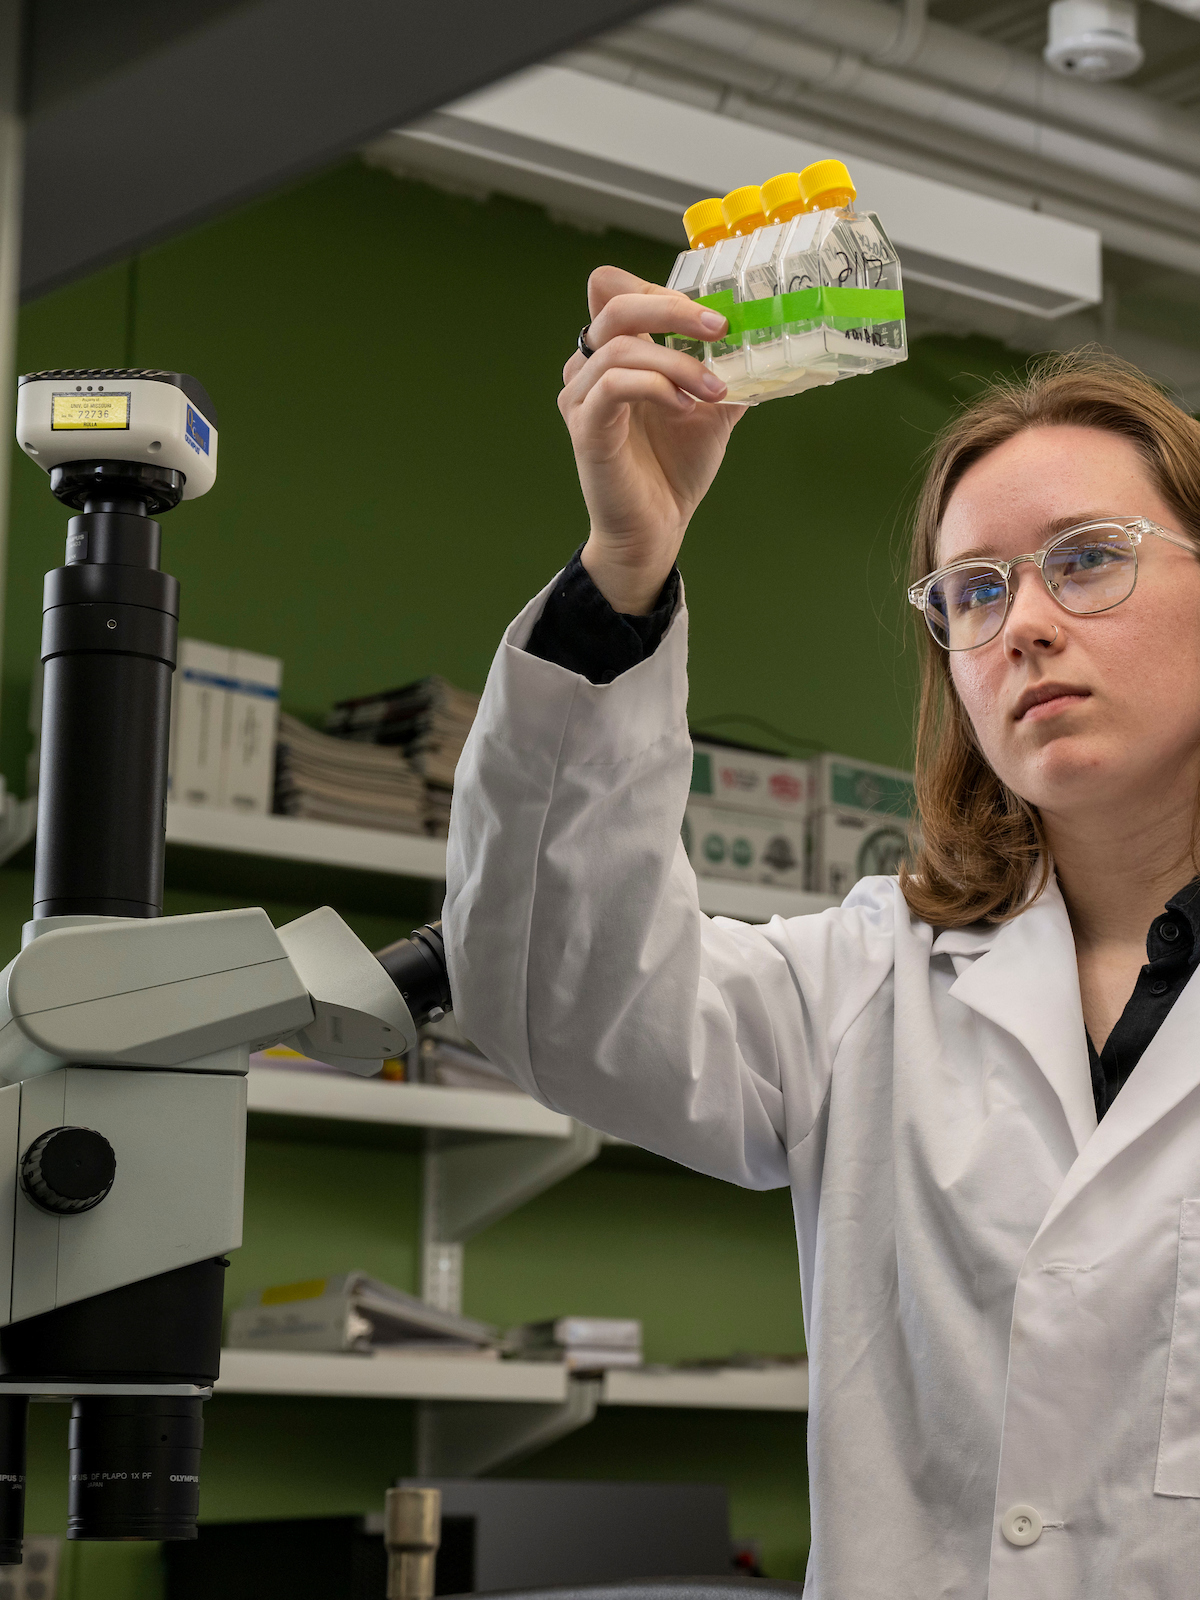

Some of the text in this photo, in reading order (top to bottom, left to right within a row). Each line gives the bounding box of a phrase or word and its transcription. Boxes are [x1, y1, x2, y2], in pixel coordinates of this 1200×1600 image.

[78, 410, 109, 418] 72736
[102, 1472, 128, 1480] PLAPO
[170, 1475, 199, 1483] OLYMPUS
